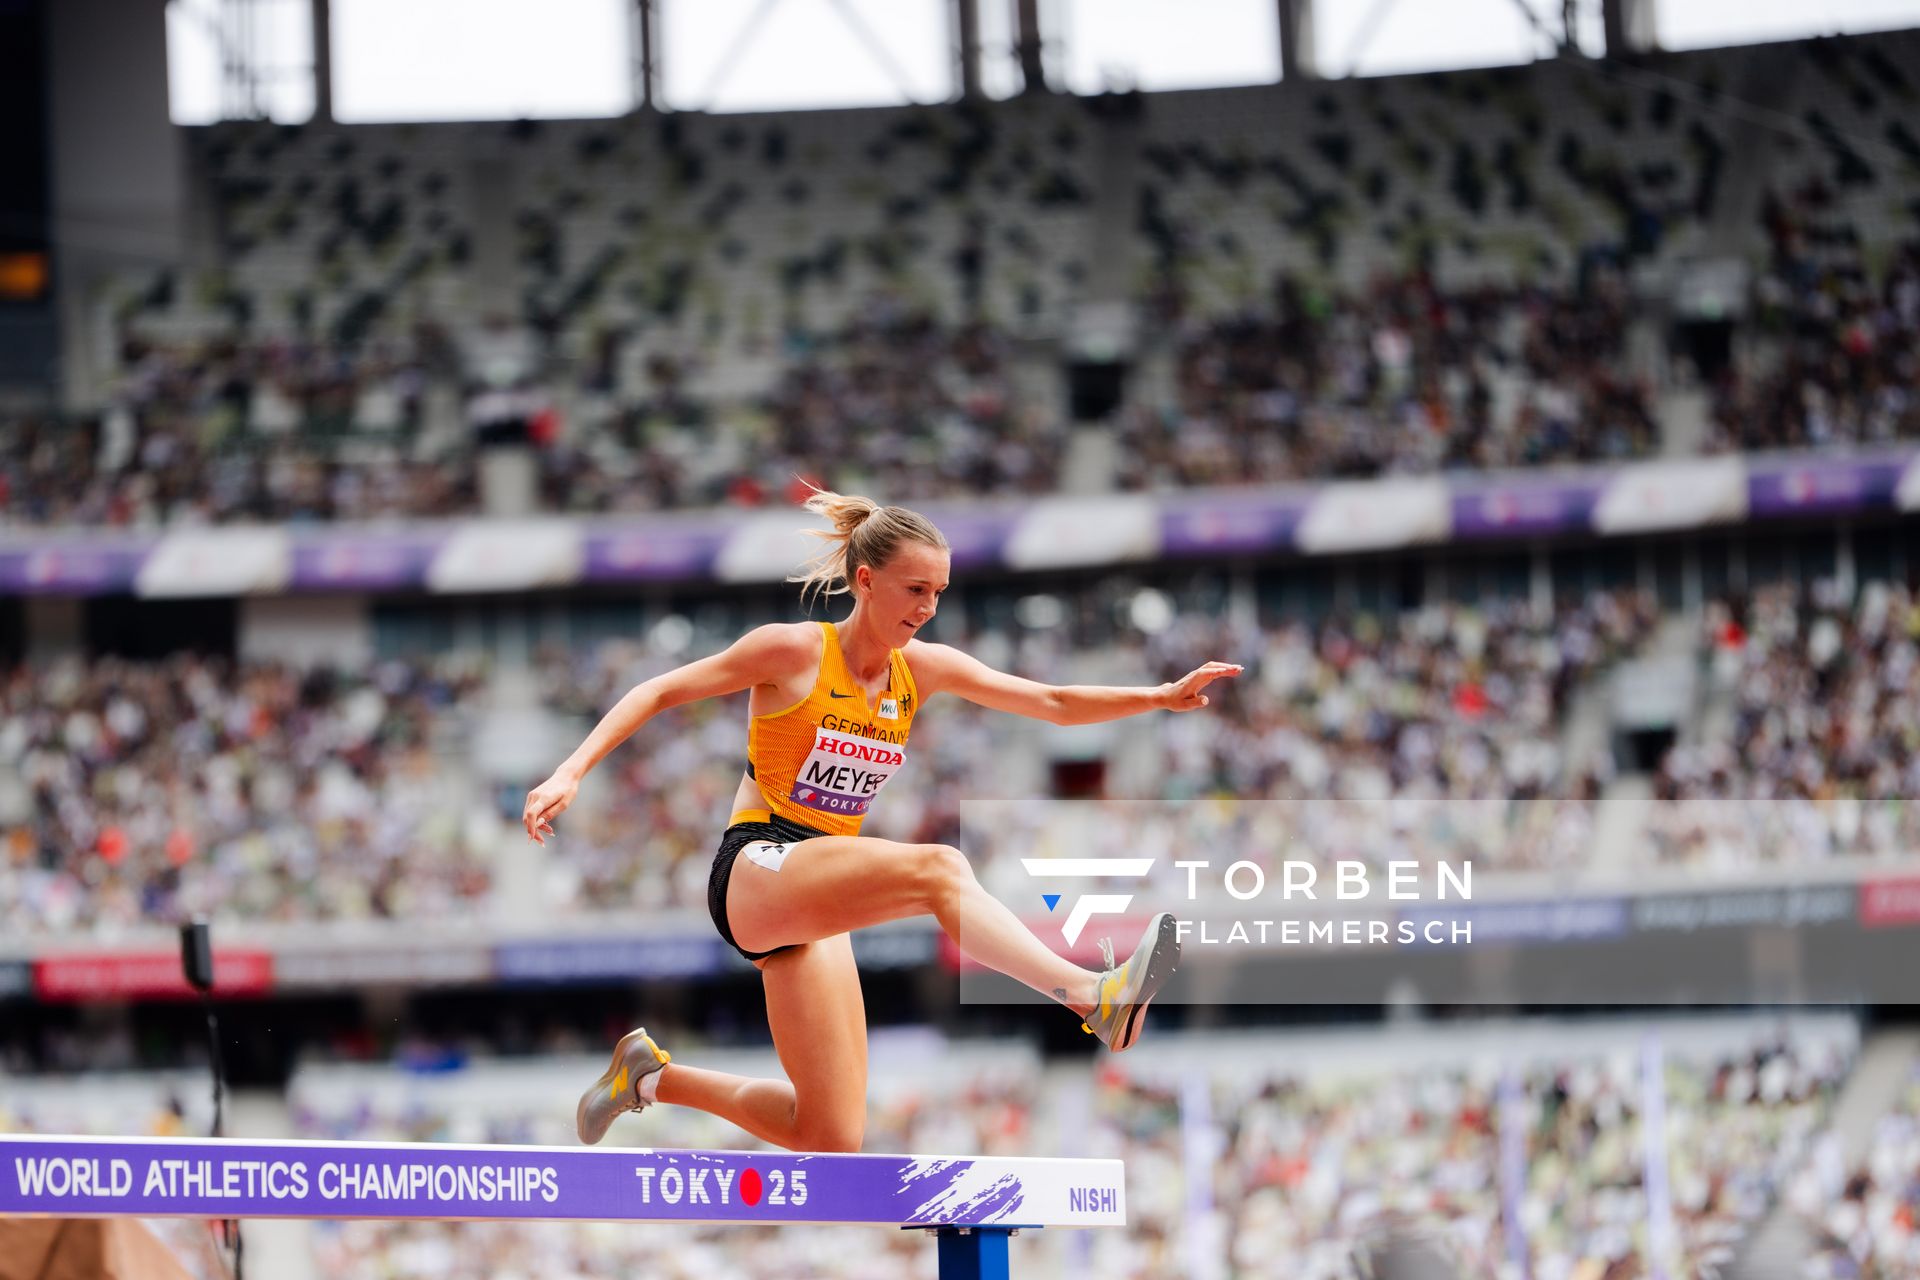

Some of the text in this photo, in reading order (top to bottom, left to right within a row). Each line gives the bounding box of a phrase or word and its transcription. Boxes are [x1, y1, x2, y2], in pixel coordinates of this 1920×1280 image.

[821, 714, 907, 745] GERMANY
[816, 736, 903, 765] HONDA
[805, 760, 888, 794] MEYER
[15, 1158, 559, 1202] WORLD ATHLETICS CHAMPIONSHIPS
[1069, 1187, 1117, 1213] NISHI
